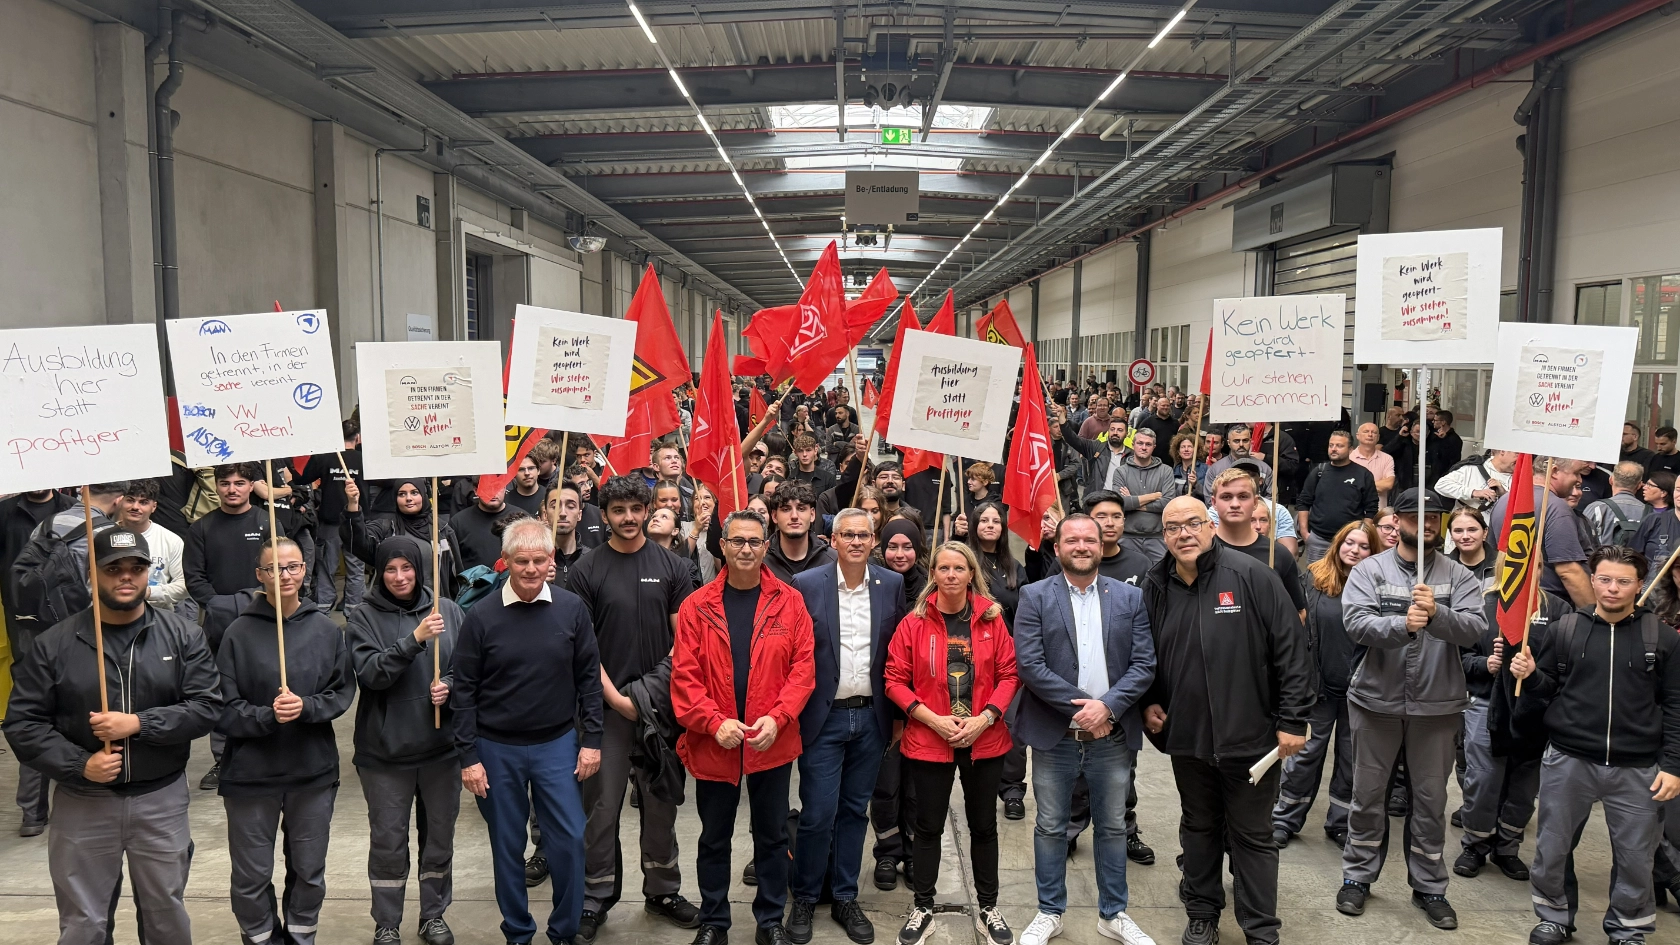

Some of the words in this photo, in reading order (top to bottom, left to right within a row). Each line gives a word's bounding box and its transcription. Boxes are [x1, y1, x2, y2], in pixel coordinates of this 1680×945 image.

[855, 185, 909, 195] Be-/Entladung
[1399, 265, 1418, 276] Kein
[1421, 257, 1443, 271] Werk
[1413, 272, 1433, 285] wird
[1401, 305, 1416, 316] Wir
[1420, 300, 1447, 312] stehen
[1222, 309, 1272, 336] Kein
[1280, 304, 1335, 330] Werk
[1402, 308, 1449, 327] zusammen!
[200, 321, 230, 336] MAN
[552, 336, 568, 347] Kein
[571, 336, 590, 347] Werk
[1254, 335, 1294, 346] wird
[3, 342, 138, 377] Ausbildung
[210, 346, 227, 364] In
[231, 349, 259, 364] den
[259, 342, 309, 359] Firmen
[564, 348, 580, 357] wird
[200, 363, 266, 387] getrennt,
[268, 362, 282, 371] in
[287, 360, 308, 370] der
[931, 363, 978, 377] Ausbildung
[54, 373, 108, 395] hier
[250, 374, 297, 387] vereint
[551, 373, 565, 384] Wir
[567, 374, 590, 383] stehen
[940, 377, 960, 389] hier
[1222, 371, 1254, 387] Wir
[1261, 371, 1314, 385] stehen
[1537, 381, 1553, 389] SACHE
[551, 382, 591, 394] zusammen!
[942, 393, 966, 403] statt
[1220, 385, 1328, 407] zusammen!
[38, 397, 97, 418] statt
[183, 404, 216, 419] BOSCH
[226, 403, 258, 419] VW
[410, 403, 428, 411] SACHE
[1545, 399, 1574, 413] Retten!
[424, 412, 437, 425] VW
[233, 416, 294, 438] Retten!
[423, 418, 453, 436] Retten!
[186, 427, 234, 462] ALSTOM
